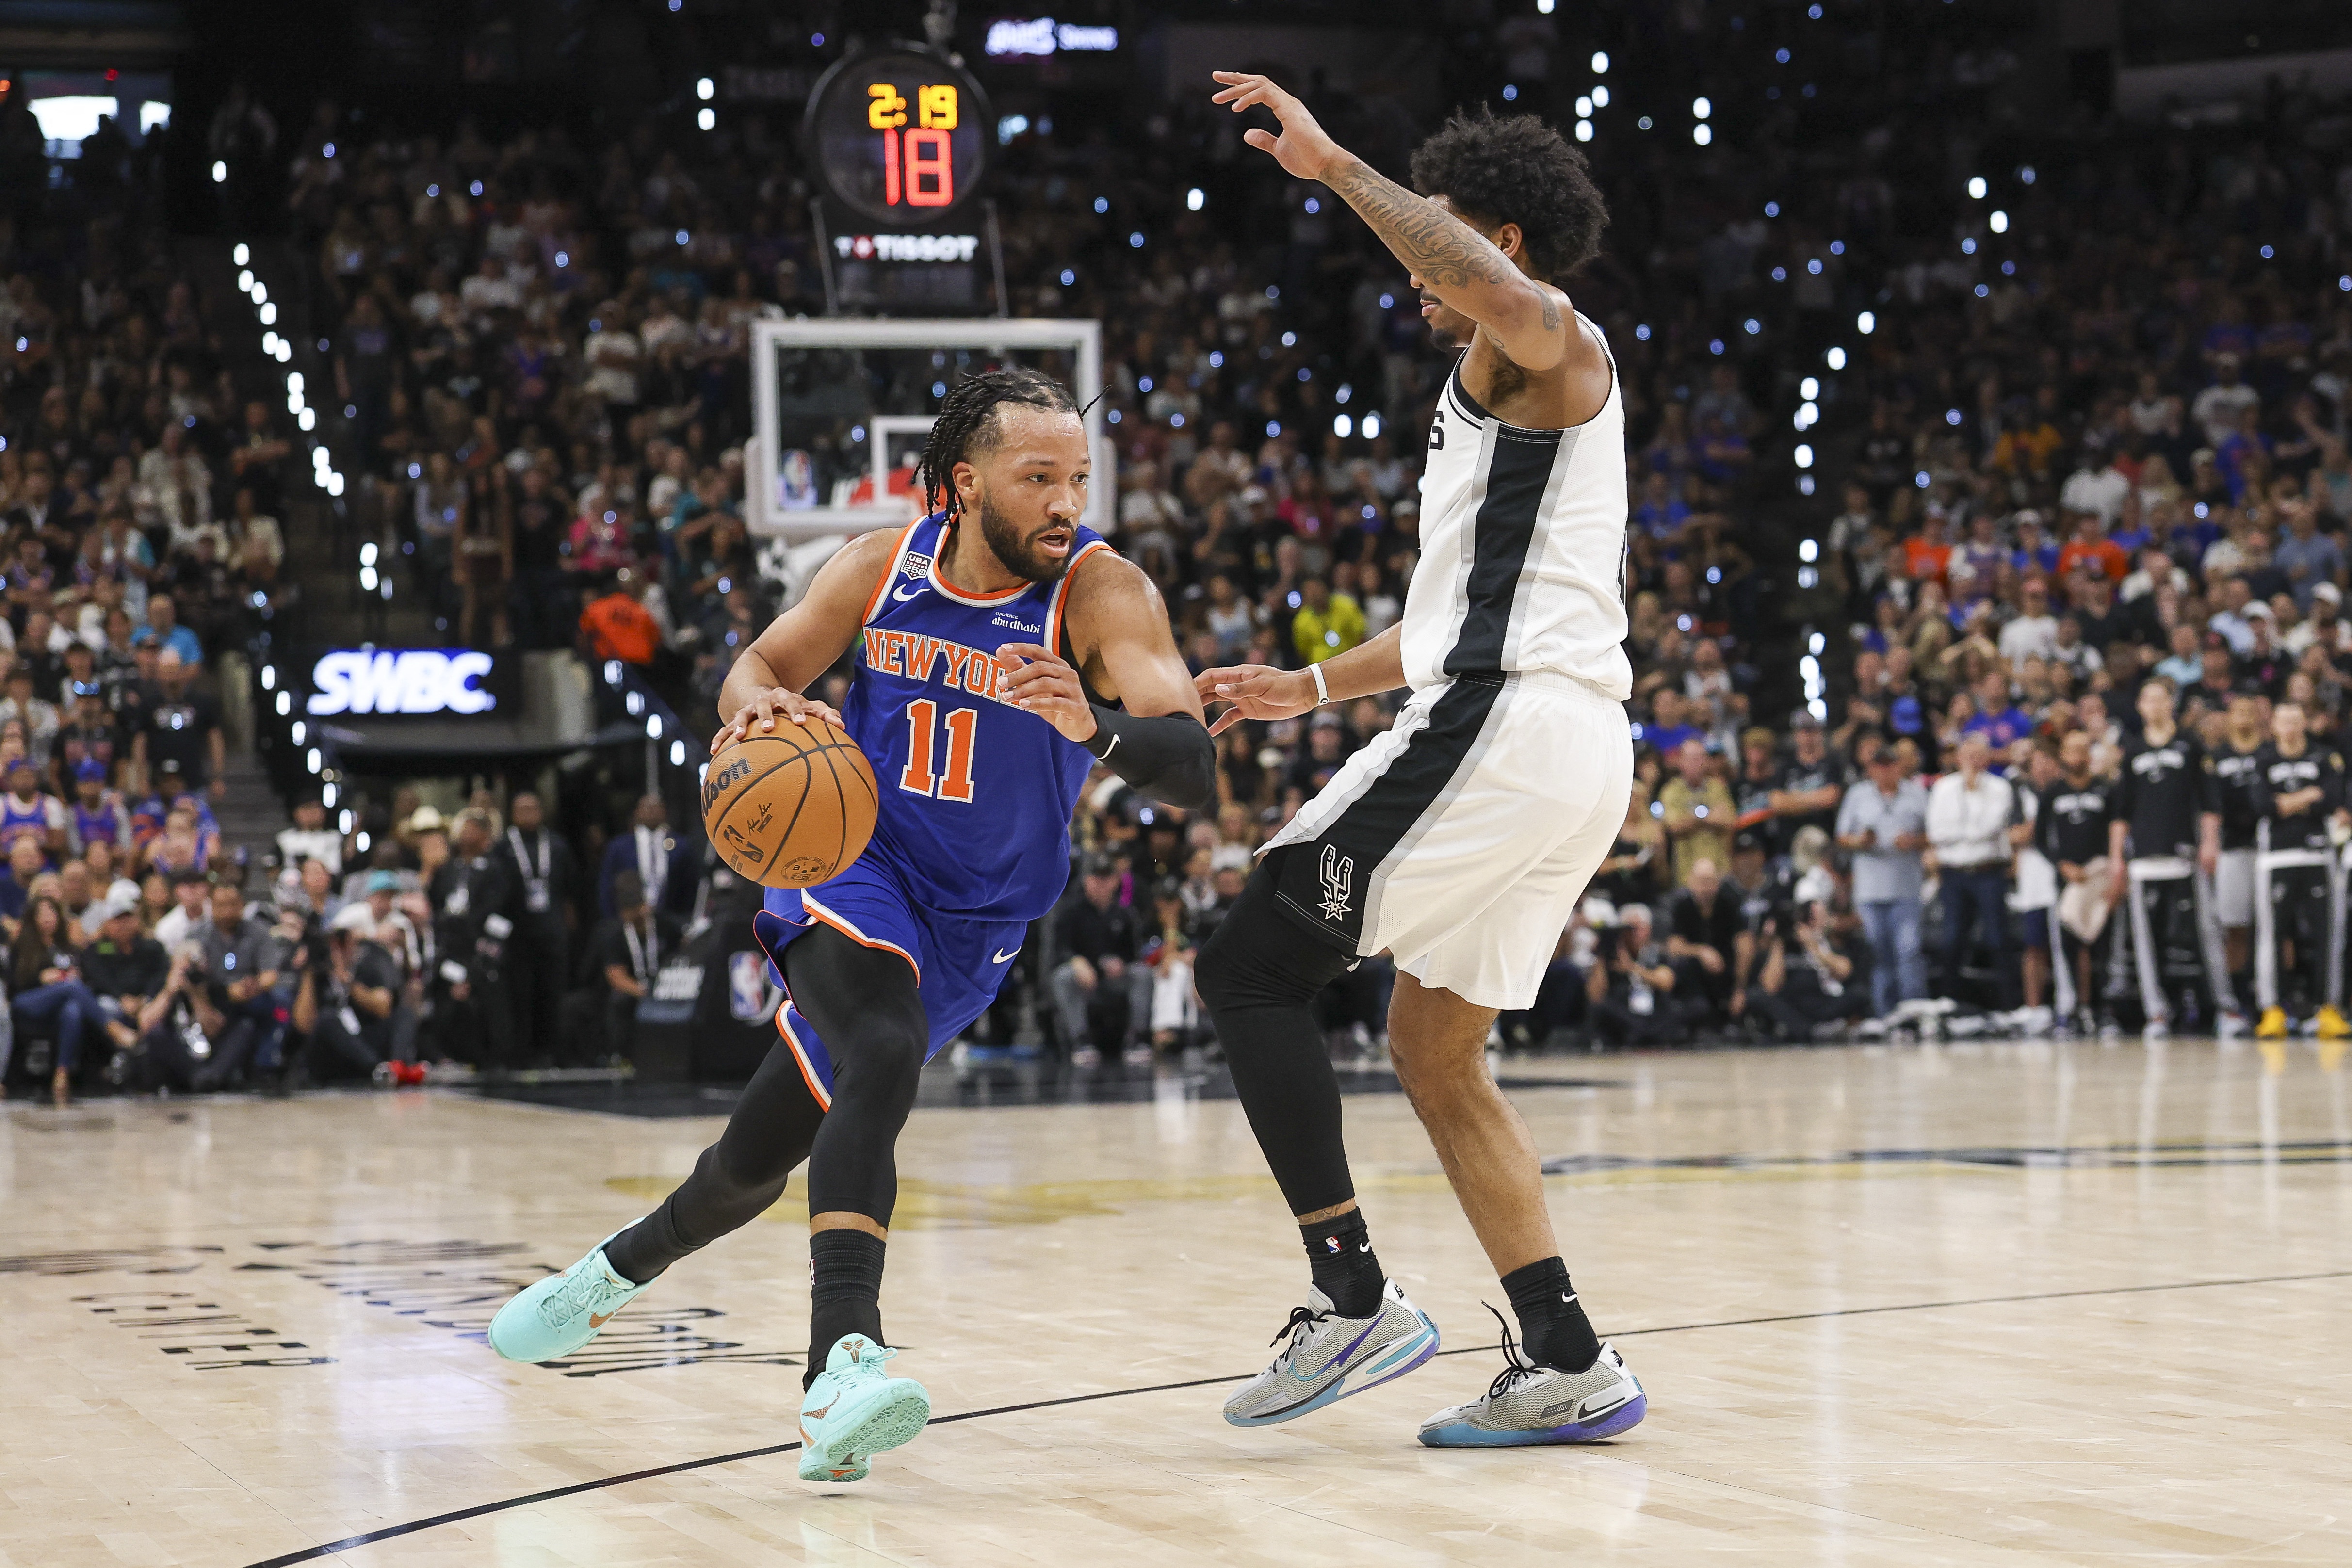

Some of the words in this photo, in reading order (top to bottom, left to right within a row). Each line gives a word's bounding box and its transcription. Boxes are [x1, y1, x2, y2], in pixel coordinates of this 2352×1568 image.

[868, 83, 958, 130] 2:19
[884, 127, 953, 206] 18
[903, 564, 926, 576] 250
[908, 555, 928, 566] USA
[991, 616, 1008, 627] abu
[1009, 620, 1041, 634] dhabi
[306, 650, 494, 716] SWBC
[863, 627, 942, 681] NEW
[942, 640, 1040, 716] YOR
[899, 697, 978, 804] 11
